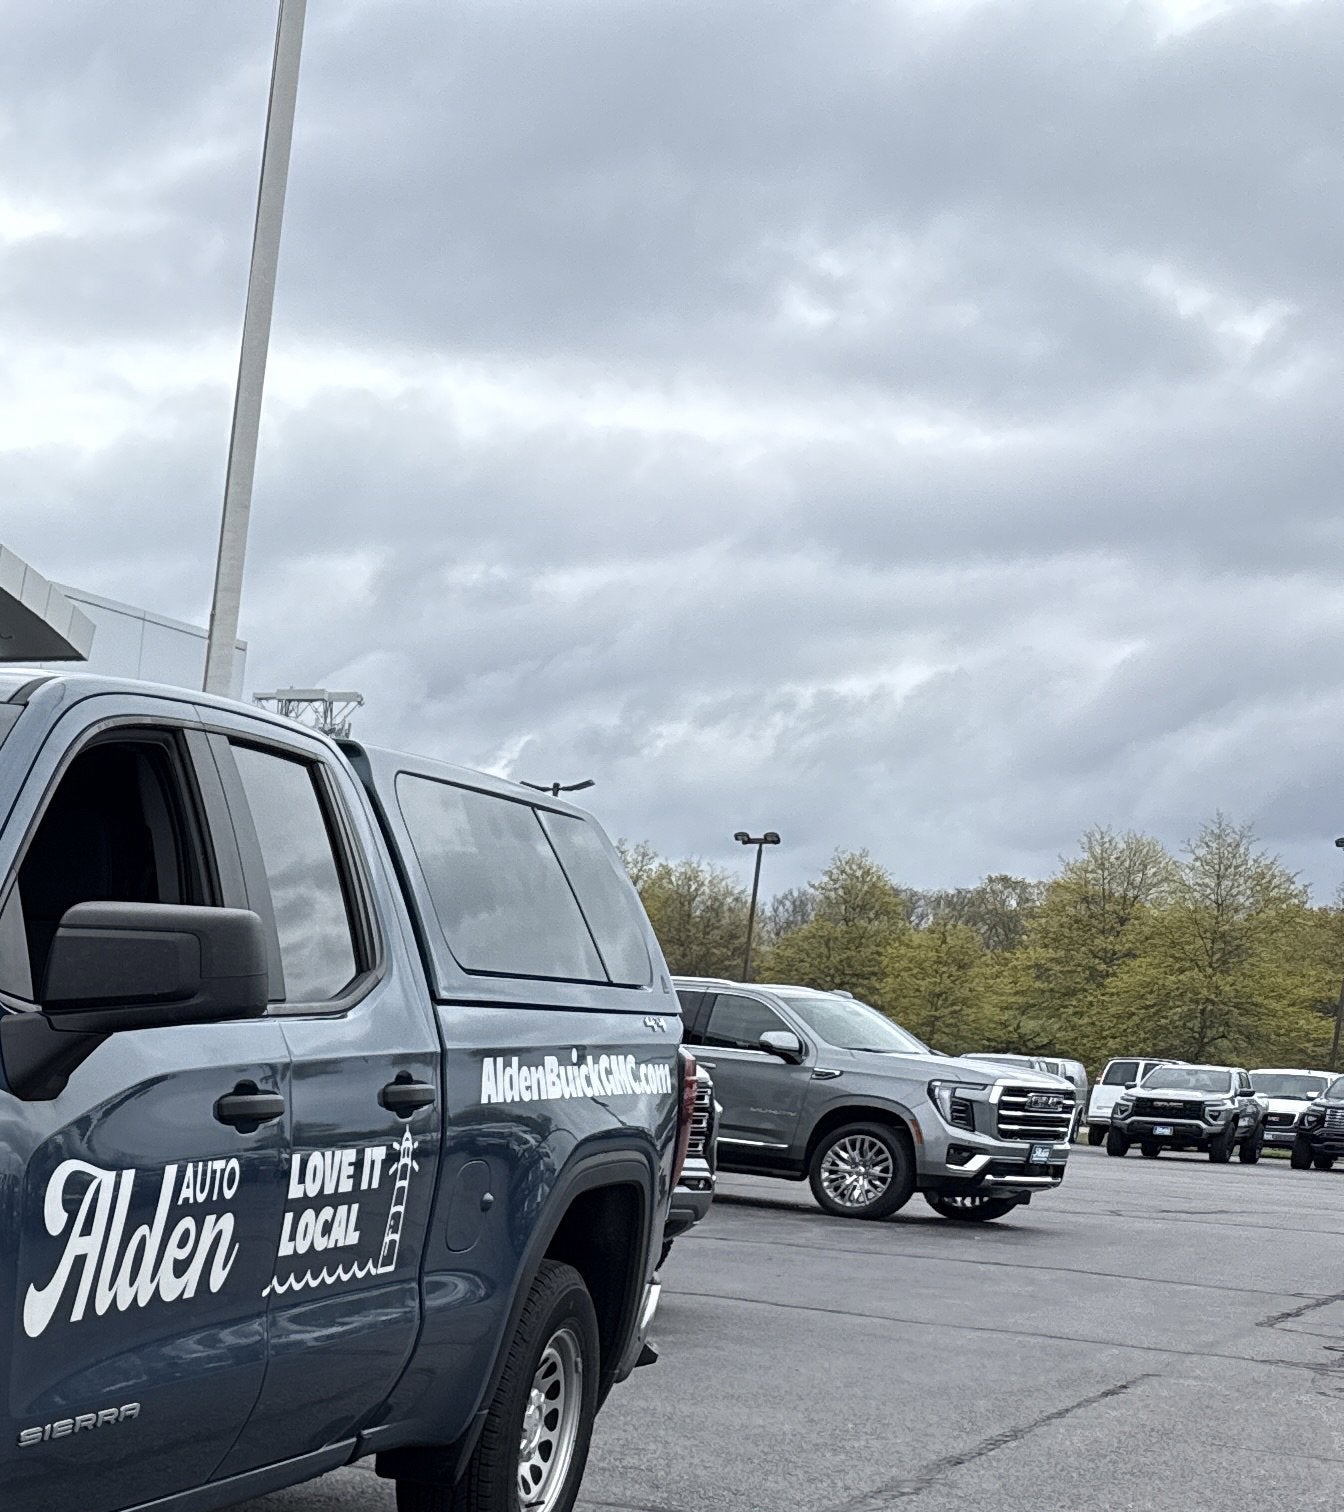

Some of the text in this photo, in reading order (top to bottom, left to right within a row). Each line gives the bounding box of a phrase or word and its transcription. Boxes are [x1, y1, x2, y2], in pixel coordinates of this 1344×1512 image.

[480, 1047, 672, 1105] AldenBuickGMC.com
[177, 1157, 240, 1206] AUTO
[287, 1145, 387, 1201] LOVE IT
[23, 1158, 240, 1338] Alden
[277, 1203, 361, 1257] LOCAL
[17, 1402, 141, 1448] SIERRA
